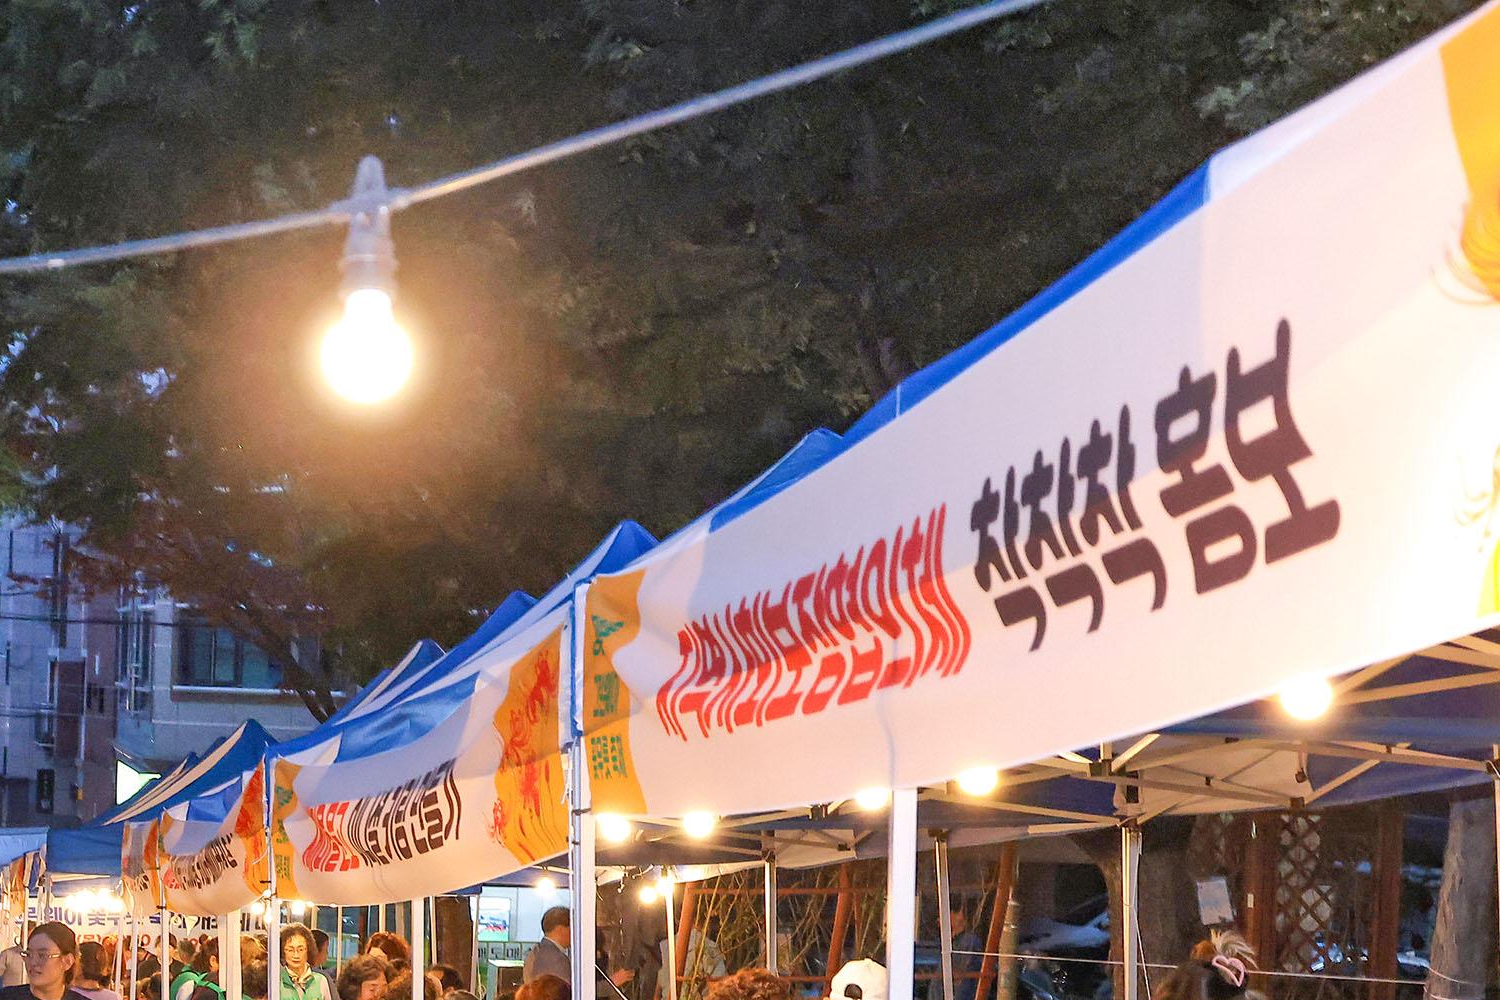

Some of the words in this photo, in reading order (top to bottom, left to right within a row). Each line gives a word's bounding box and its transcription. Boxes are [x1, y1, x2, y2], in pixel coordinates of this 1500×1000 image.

[655, 501, 972, 742] 지역사회보장협의체
[970, 403, 1168, 653] 착착착
[1153, 316, 1341, 596] 홍보
